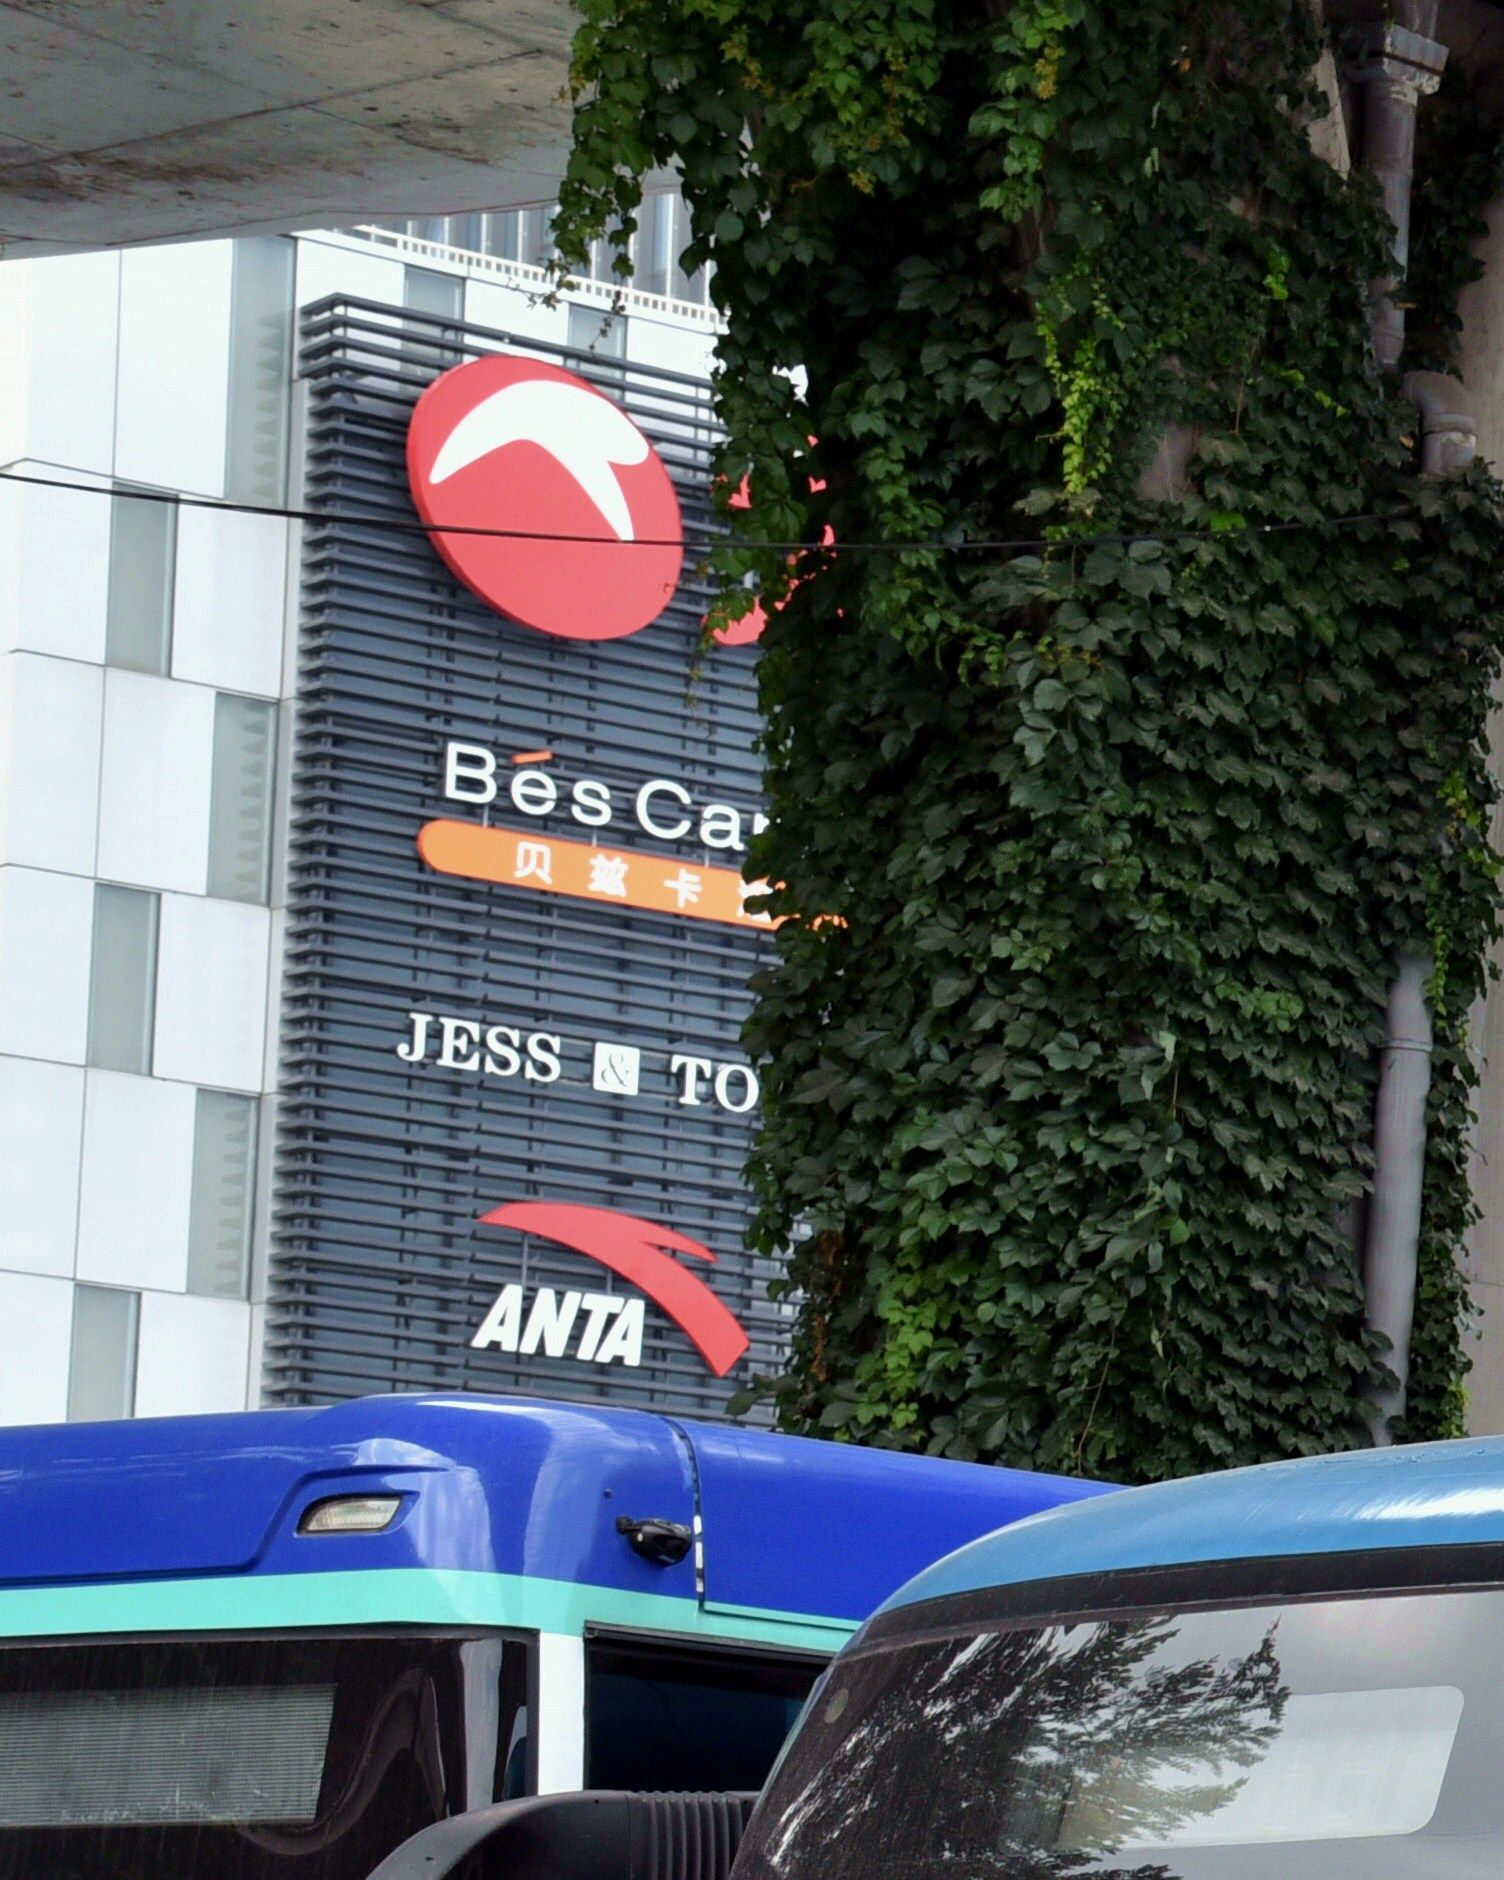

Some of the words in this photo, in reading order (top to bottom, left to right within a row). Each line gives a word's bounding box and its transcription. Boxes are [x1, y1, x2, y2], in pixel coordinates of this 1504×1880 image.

[397, 1013, 562, 1083] JESS
[597, 1045, 637, 1093] &
[471, 1284, 646, 1367] ANTA
